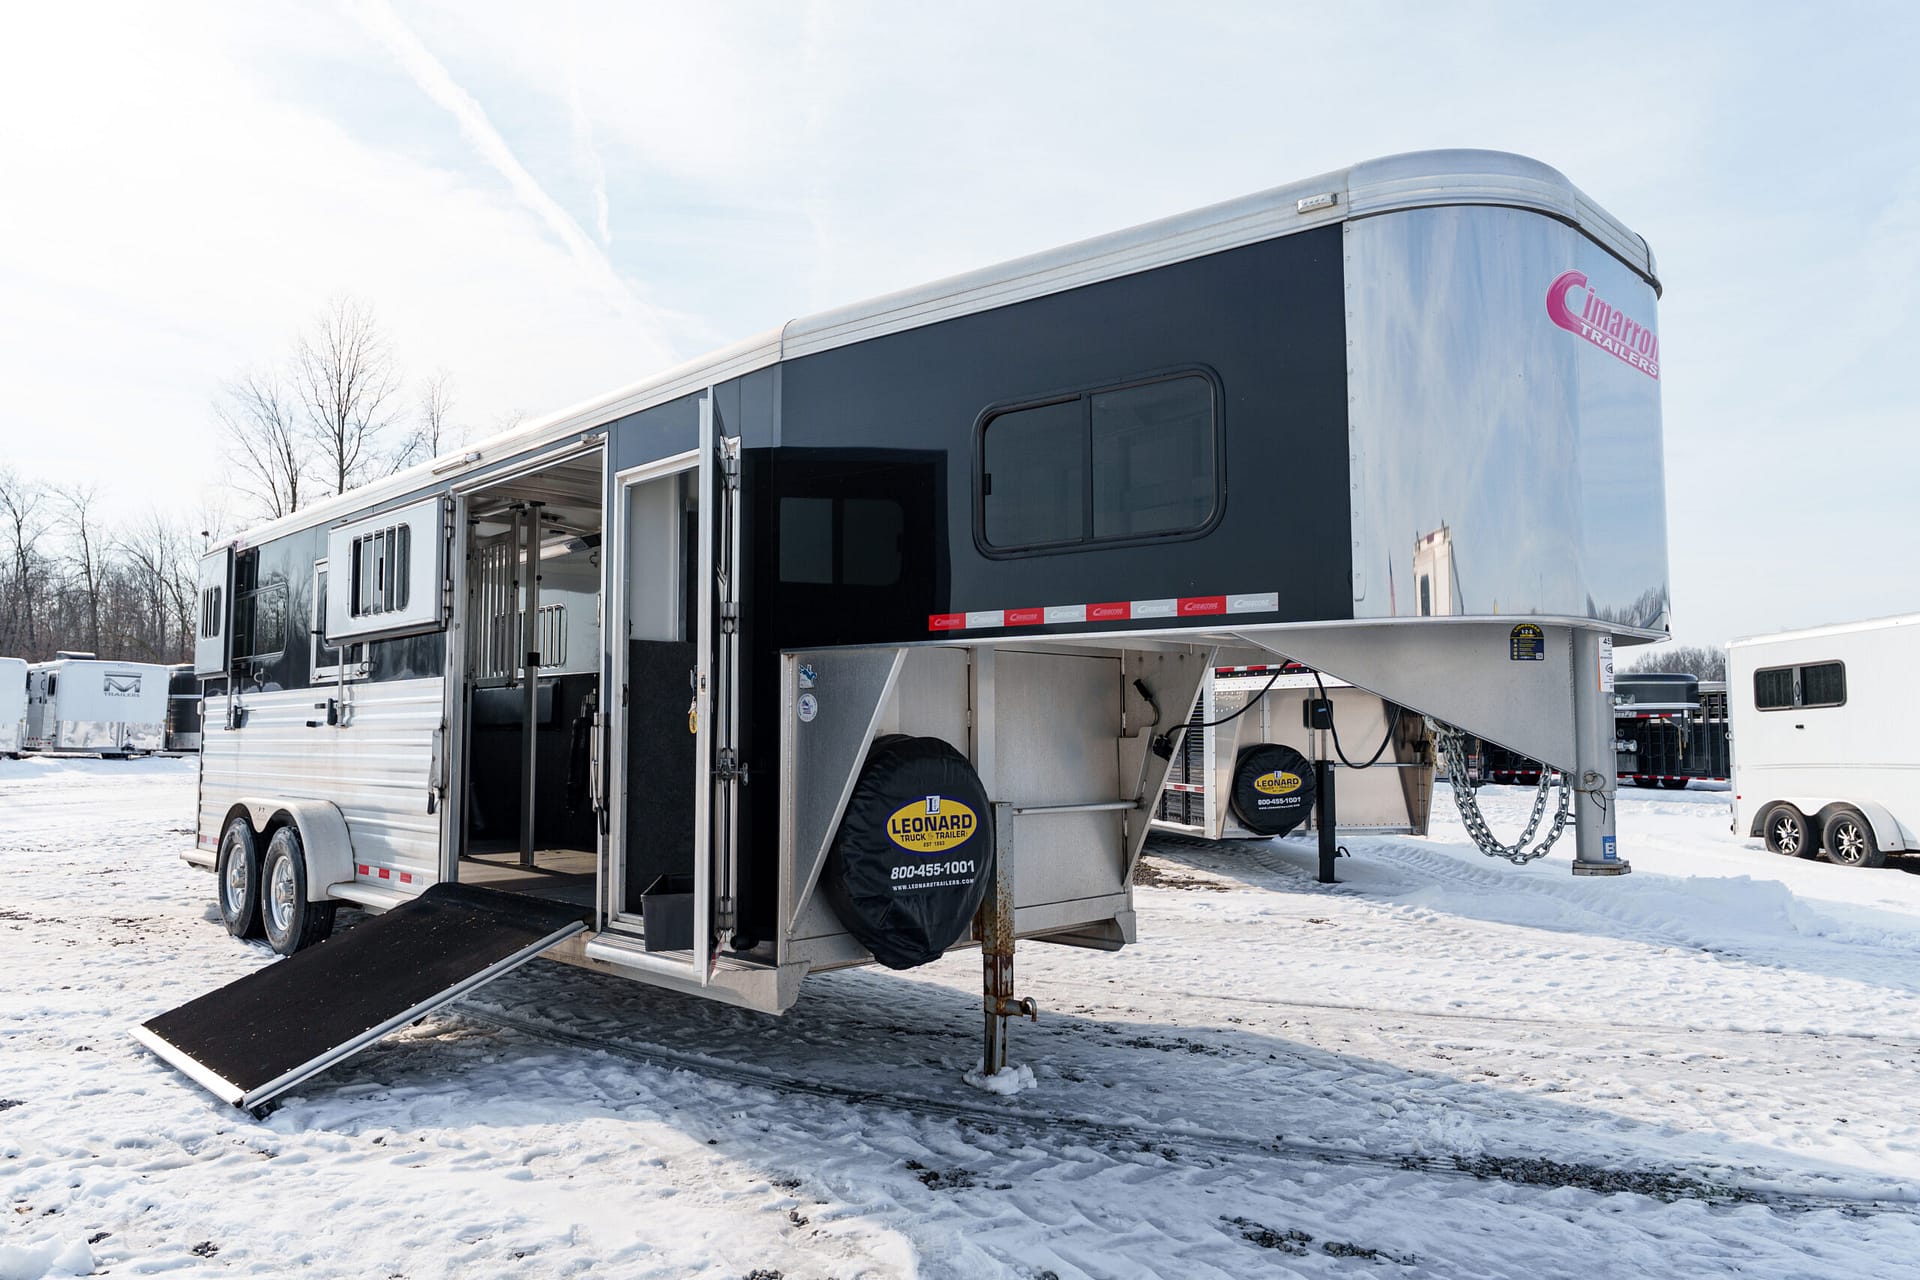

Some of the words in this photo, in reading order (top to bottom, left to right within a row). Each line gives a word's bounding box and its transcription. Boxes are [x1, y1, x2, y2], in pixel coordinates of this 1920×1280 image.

[1580, 322, 1658, 376] TRAILERS
[1256, 778, 1299, 787] LEONARD
[892, 814, 972, 834] LEONARD
[901, 833, 926, 842] TRUCK
[936, 830, 966, 840] TRAILER
[891, 860, 975, 880] 800-455-1001
[892, 879, 974, 890] WWW.LEONARDTRAILERS.COM
